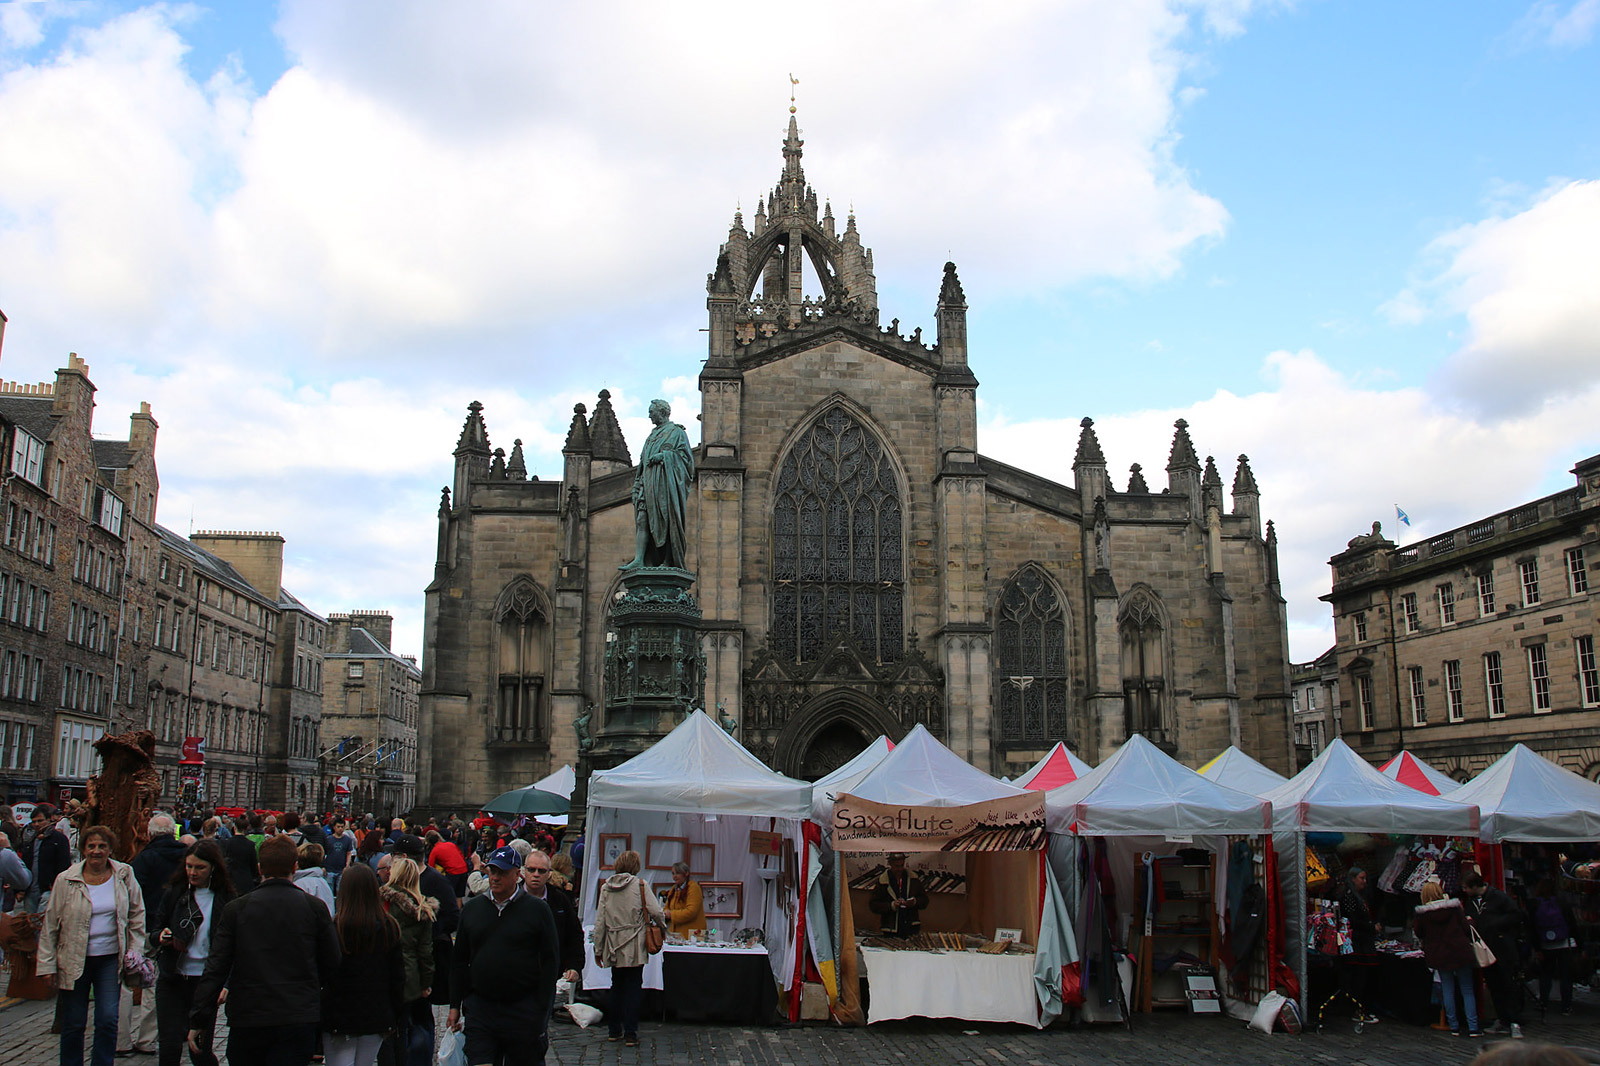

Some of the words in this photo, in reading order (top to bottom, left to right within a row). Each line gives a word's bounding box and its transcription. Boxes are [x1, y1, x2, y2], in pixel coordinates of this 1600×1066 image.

[834, 808, 954, 831] Saxaflute
[984, 809, 999, 823] just
[1004, 810, 1018, 820] like
[1032, 804, 1045, 817] real
[837, 829, 877, 841] handmade
[878, 828, 908, 838] bamboo
